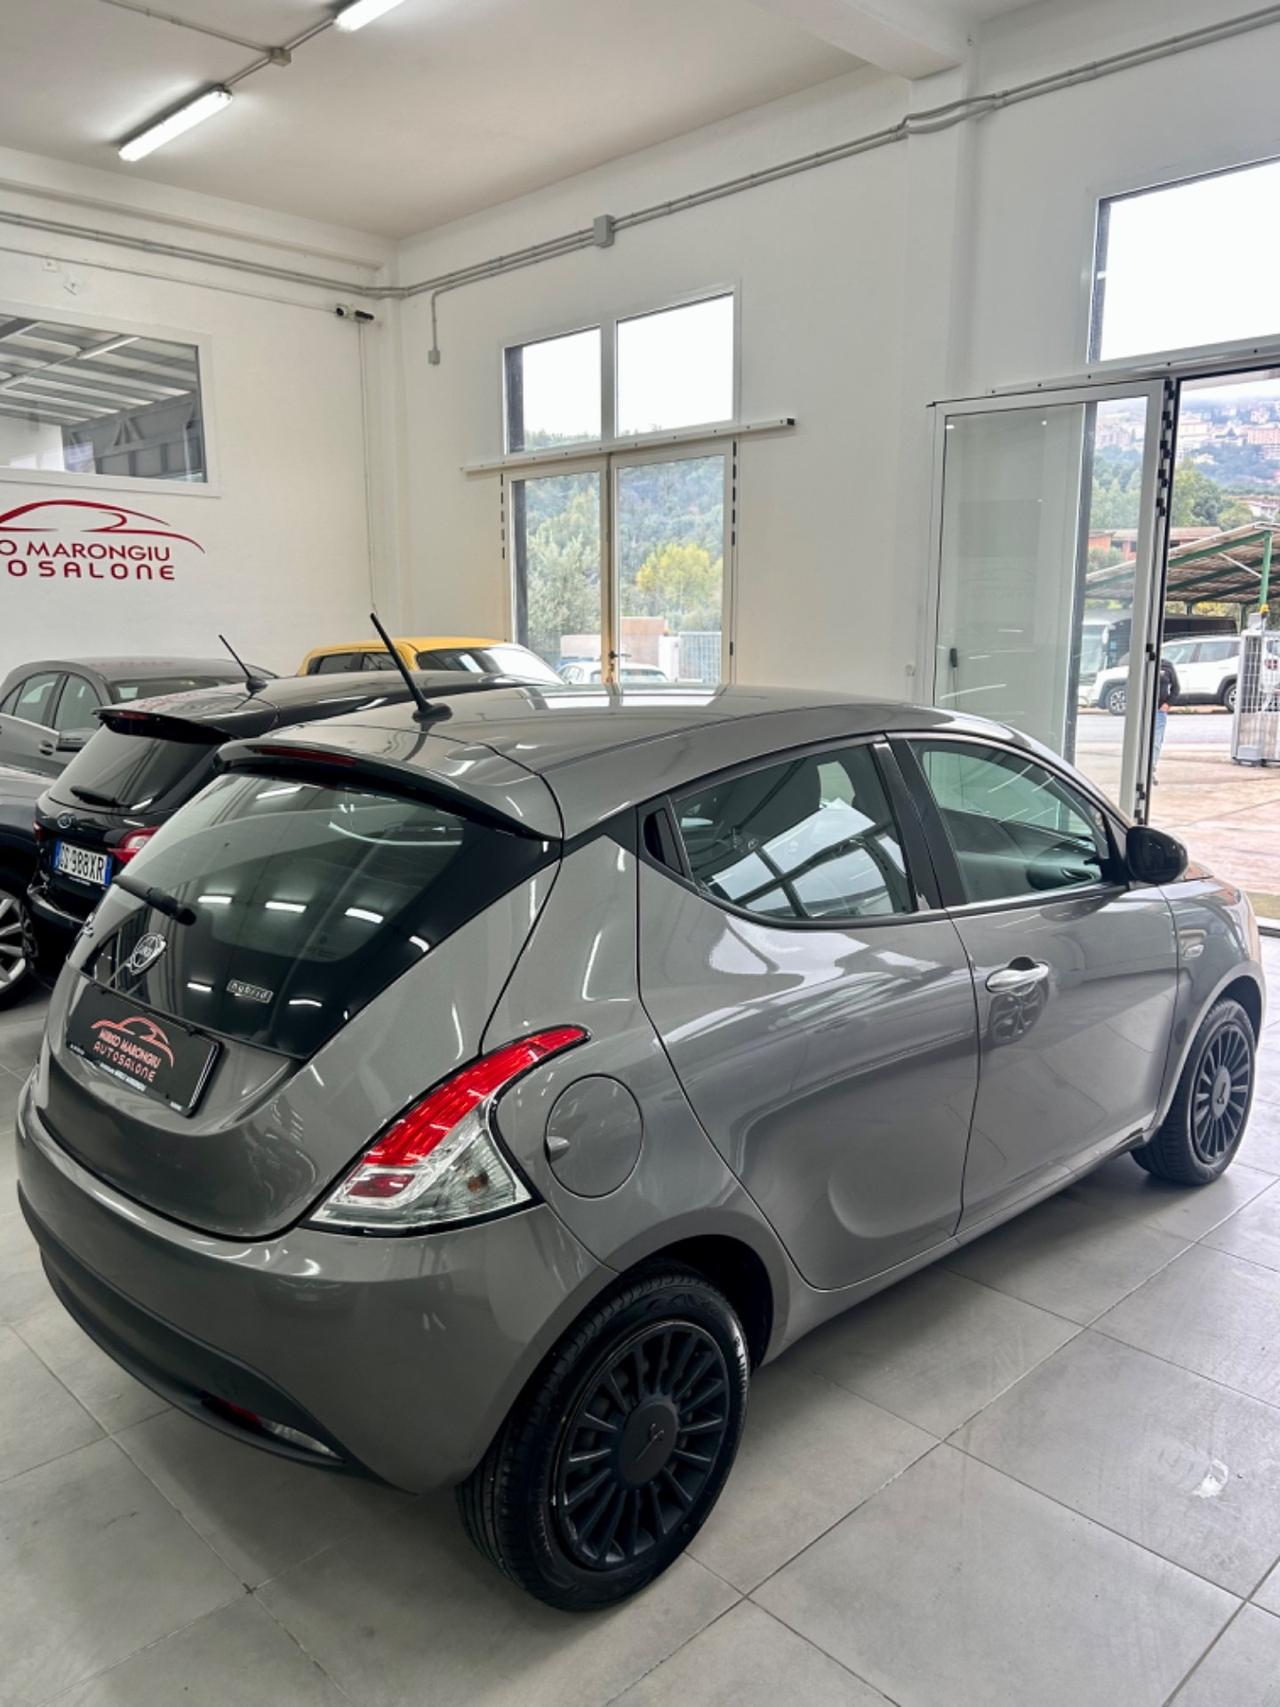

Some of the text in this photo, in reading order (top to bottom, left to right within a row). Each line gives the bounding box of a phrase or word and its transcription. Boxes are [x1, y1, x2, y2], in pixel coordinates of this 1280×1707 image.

[26, 541, 170, 561] MARONGIU
[8, 560, 175, 580] OSALONE
[93, 1041, 157, 1083] AUTOSALONE
